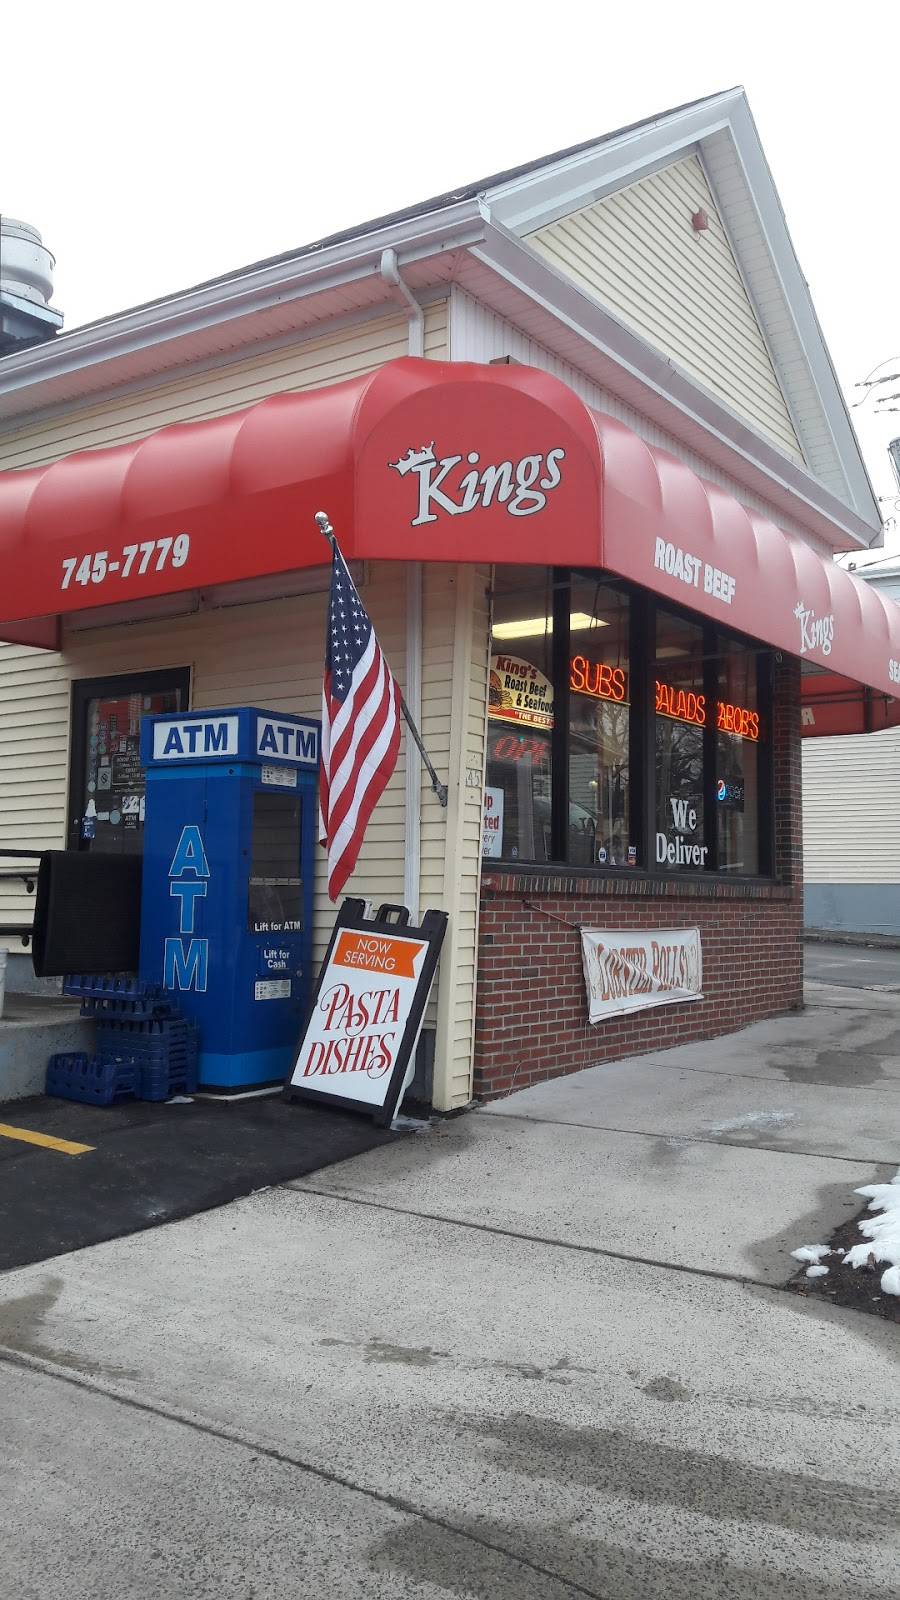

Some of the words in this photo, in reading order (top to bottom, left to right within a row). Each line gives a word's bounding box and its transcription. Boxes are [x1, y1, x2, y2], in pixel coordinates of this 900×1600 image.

[411, 447, 565, 527] Kings
[60, 534, 190, 590] 745-7779
[654, 536, 703, 588] ROAST
[704, 561, 736, 605] BEEF
[799, 608, 835, 656] Kings
[496, 655, 538, 680] King's
[570, 655, 626, 700] SUBS
[504, 674, 528, 693] Roast
[528, 681, 547, 698] Beef
[516, 693, 522, 706] &
[717, 701, 759, 738] ABOB'S
[163, 723, 228, 754] ATM
[259, 724, 316, 759] ATM
[669, 798, 697, 831] We
[655, 833, 708, 866] Deliver
[163, 826, 210, 992] ATM
[254, 922, 269, 932] Lift
[270, 922, 282, 931] for
[283, 921, 300, 930] ATM
[263, 949, 278, 959] Lift
[279, 950, 290, 959] for
[343, 951, 396, 970] SERVING
[356, 938, 392, 954] NOW
[267, 959, 286, 968] Cash
[320, 983, 400, 1037] PASTA
[303, 1032, 396, 1079] DISHES
